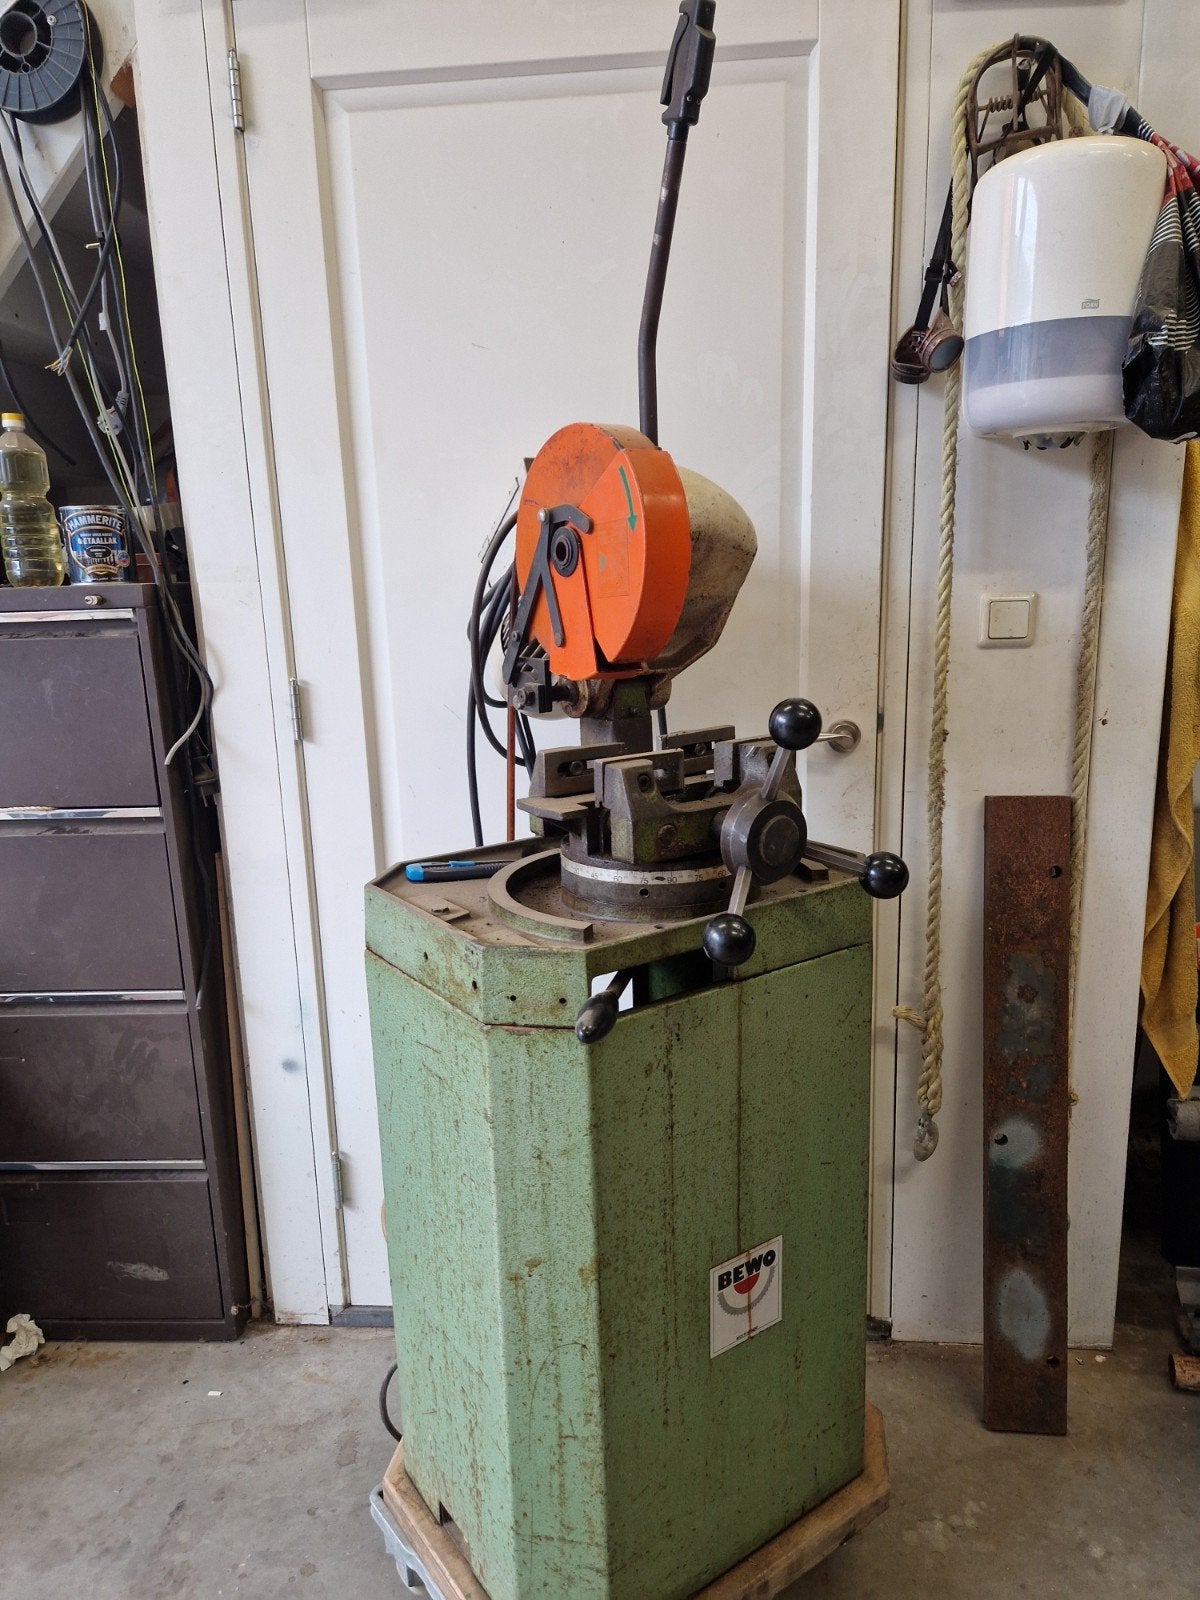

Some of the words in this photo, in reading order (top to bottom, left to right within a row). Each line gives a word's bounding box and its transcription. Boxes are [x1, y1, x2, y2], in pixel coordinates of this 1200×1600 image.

[68, 515, 123, 531] HAMMERITE
[667, 876, 678, 884] 90
[694, 874, 704, 882] 75
[717, 1249, 776, 1292] BEWO
